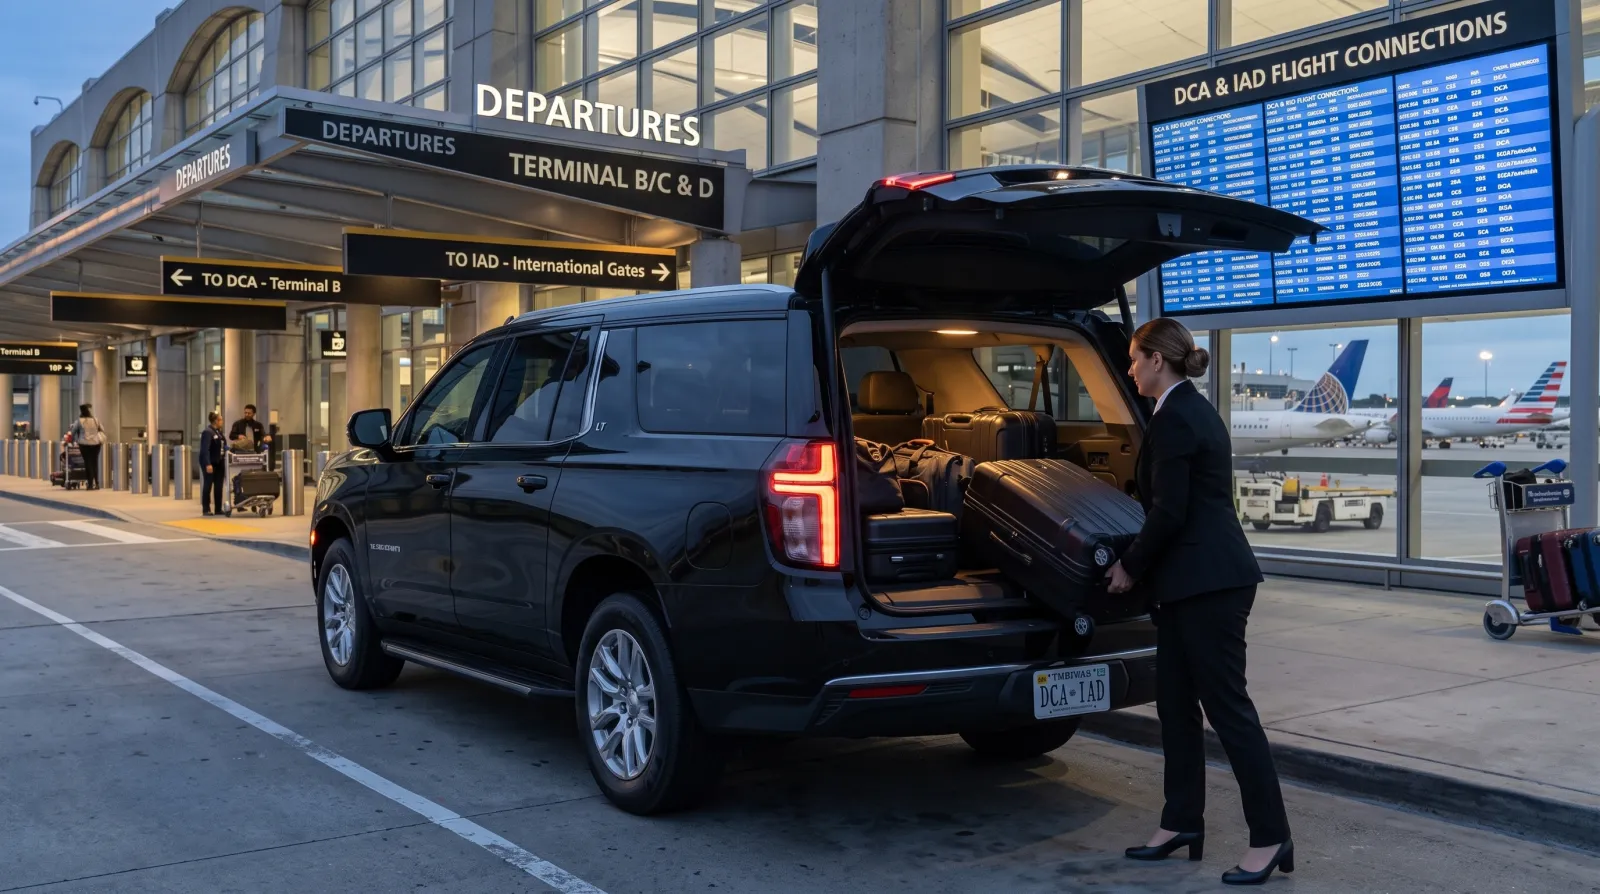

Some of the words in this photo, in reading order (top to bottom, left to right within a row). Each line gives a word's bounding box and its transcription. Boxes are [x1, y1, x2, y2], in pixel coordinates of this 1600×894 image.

[1174, 81, 1211, 105] DCA
[1215, 77, 1229, 96] &
[1233, 69, 1266, 92] IAD
[1271, 51, 1339, 84] FLIGHT
[1344, 11, 1508, 67] CONNECTIONS
[476, 83, 701, 147] DEPARTURES
[322, 120, 456, 156] DEPARTURES
[176, 143, 231, 191] DEPARTURES
[509, 152, 629, 189] TERMINAL
[635, 169, 671, 194] B/C
[676, 174, 692, 197] &
[699, 176, 714, 199] D
[445, 251, 468, 267] TO
[472, 253, 499, 269] IAD
[513, 256, 603, 276] International
[607, 262, 645, 278] Gates
[201, 272, 223, 287] TO
[227, 274, 258, 289] DCA
[270, 277, 329, 293] Terminal
[332, 281, 341, 293] B
[0, 347, 33, 356] Terminal
[595, 421, 607, 432] LT
[1040, 684, 1068, 708] DCA
[1079, 679, 1105, 703] IAD
